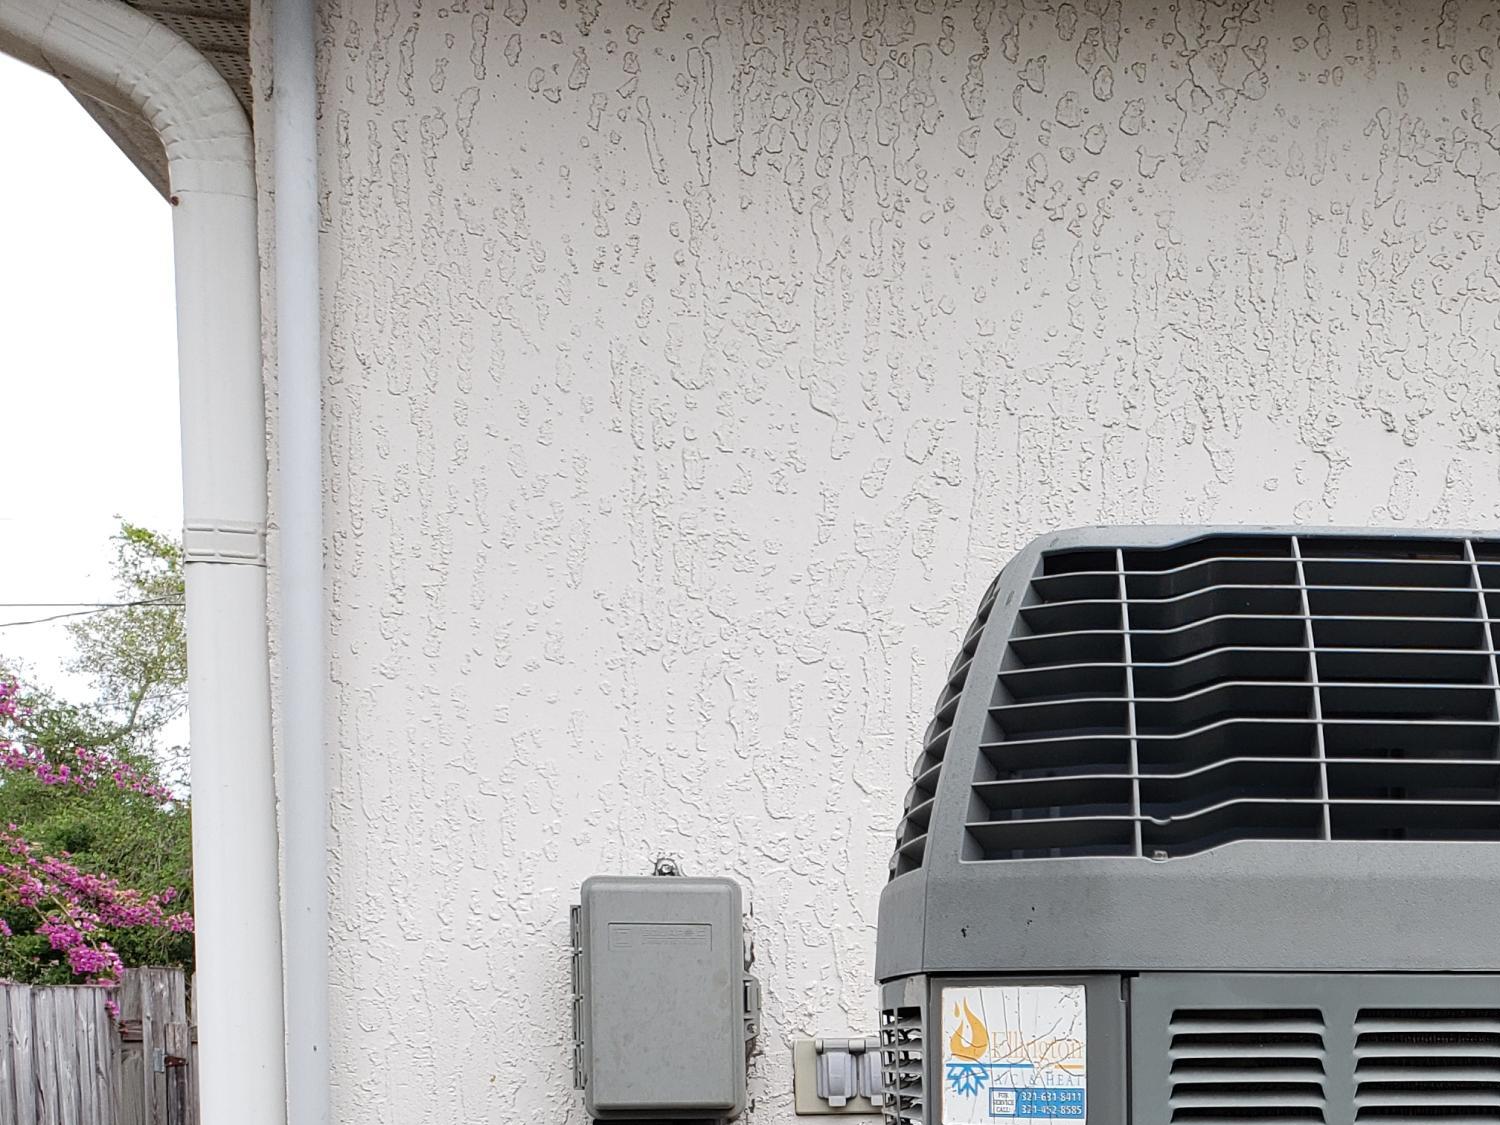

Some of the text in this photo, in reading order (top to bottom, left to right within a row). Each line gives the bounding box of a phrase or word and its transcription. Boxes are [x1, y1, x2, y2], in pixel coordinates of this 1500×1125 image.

[1029, 1074, 1038, 1086] &
[1046, 1073, 1083, 1086] HEAT
[1021, 1091, 1082, 1101] 321-631-8411
